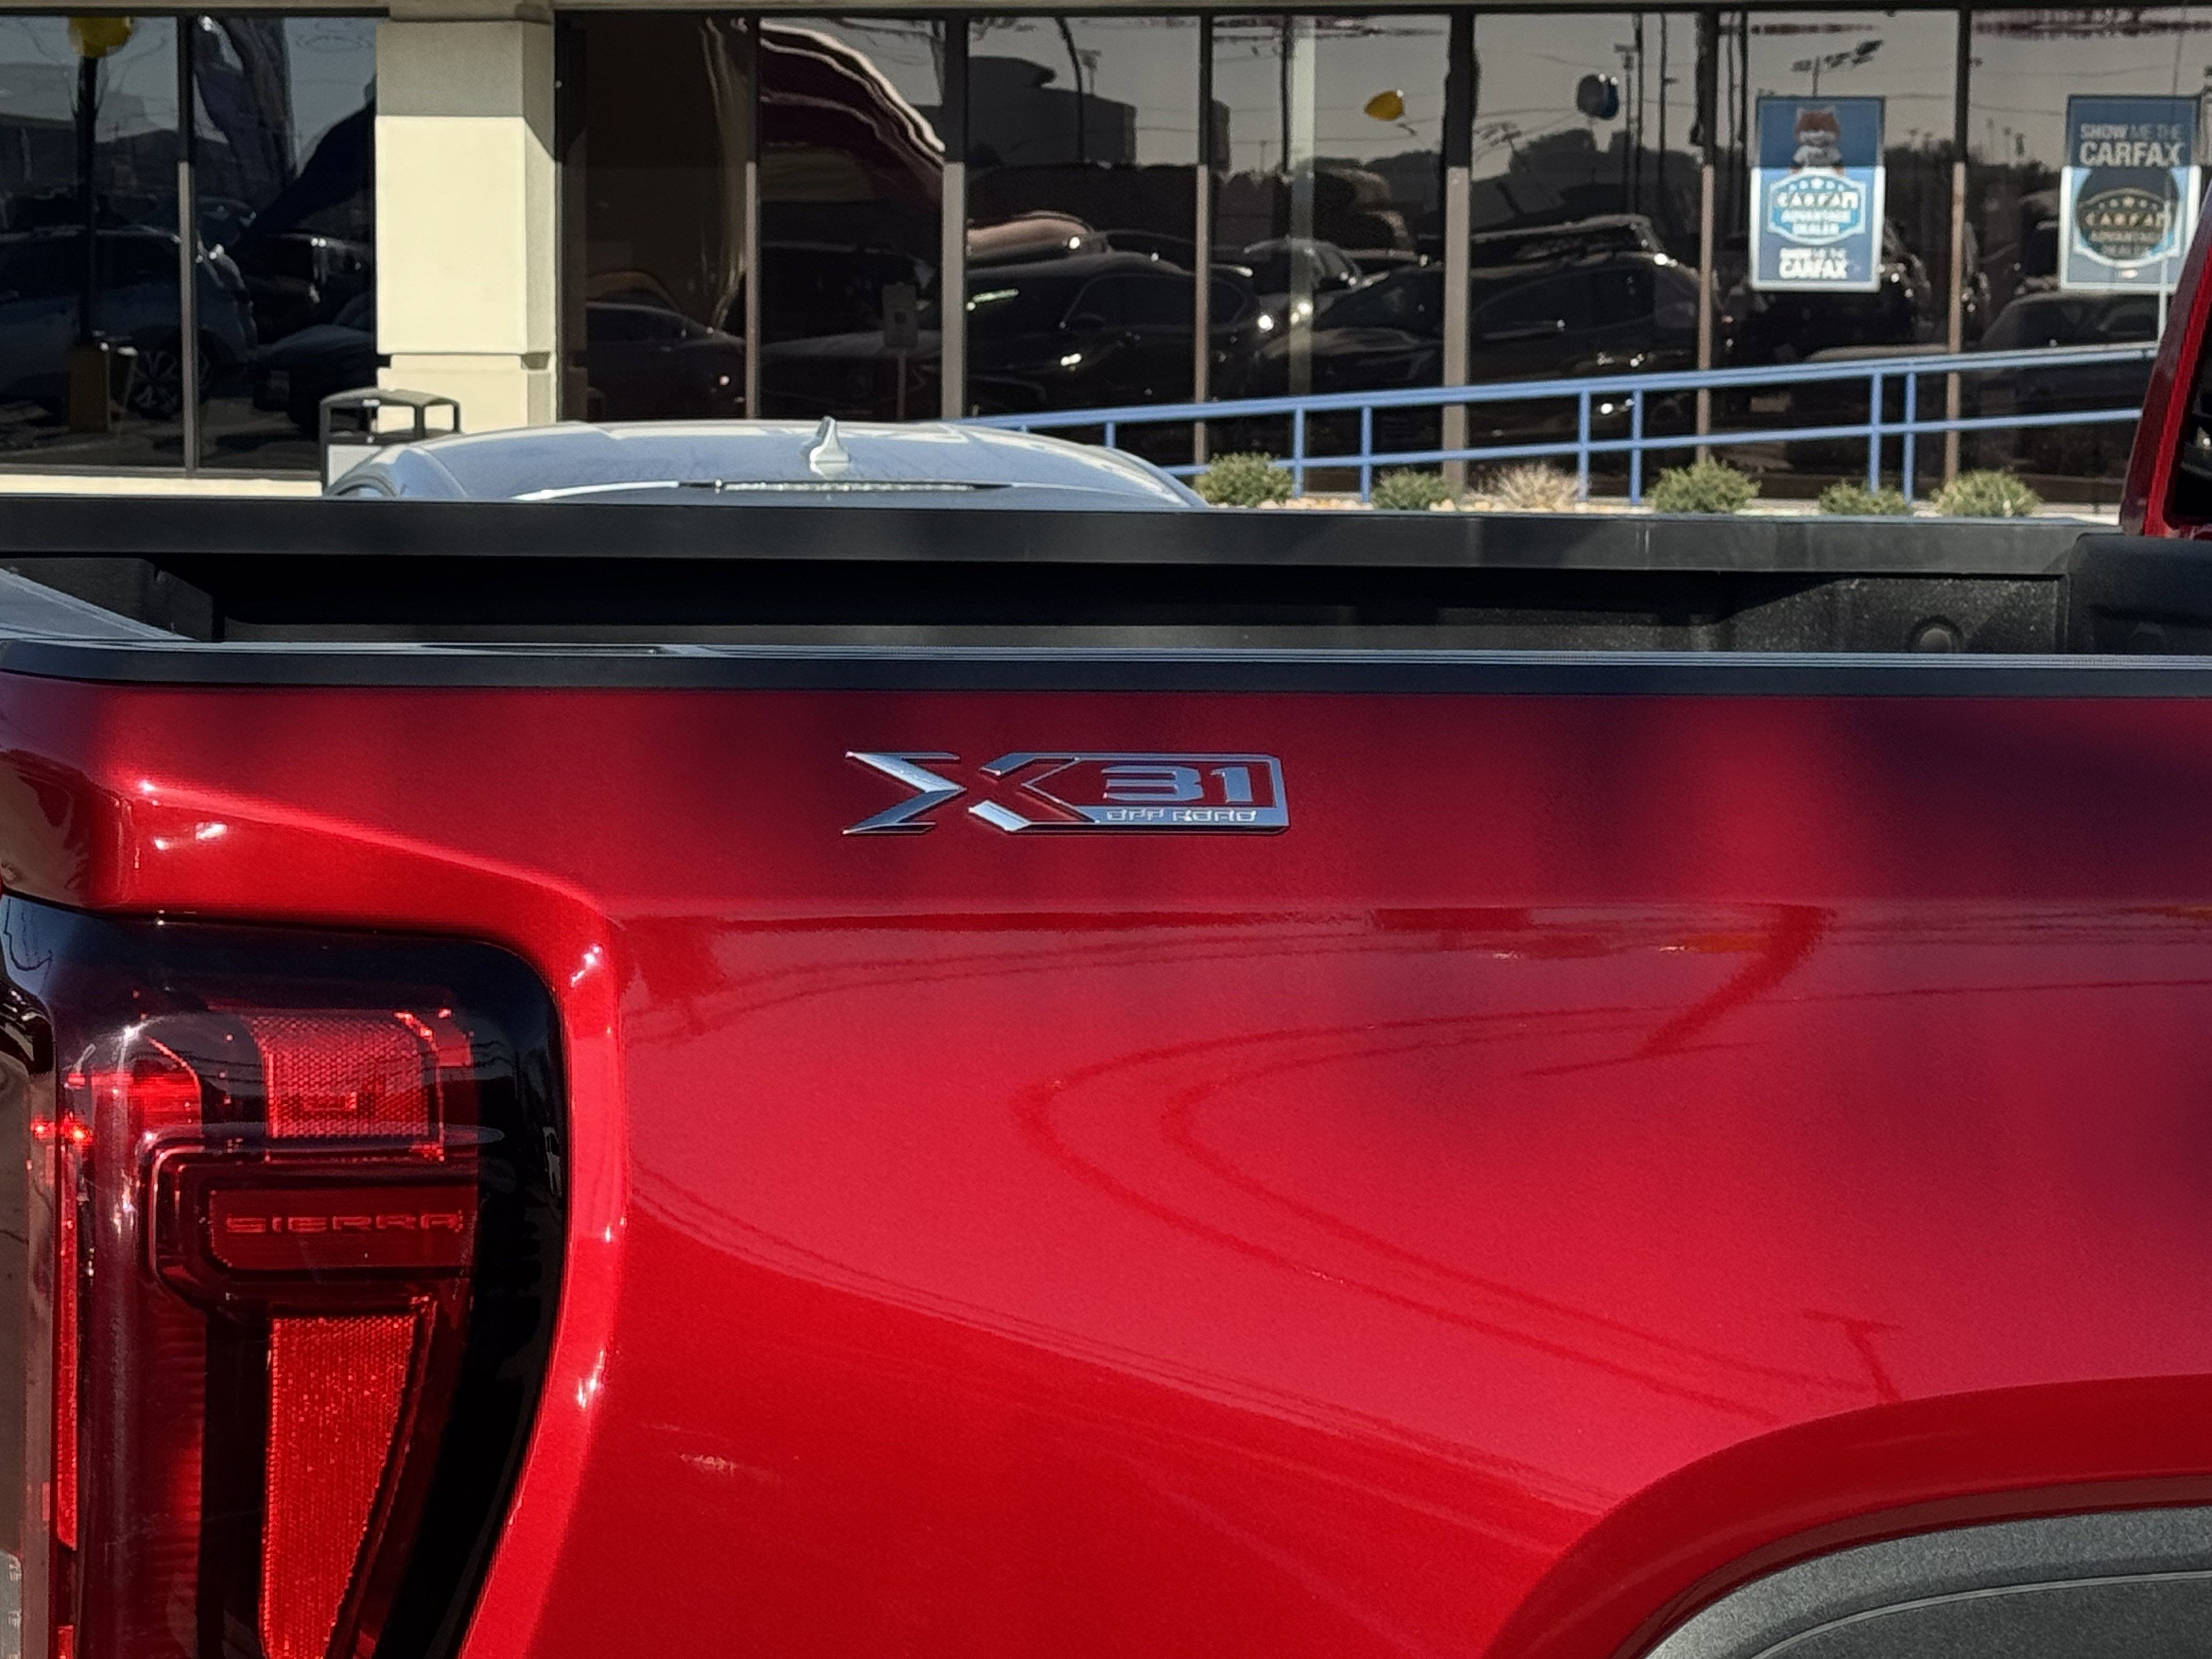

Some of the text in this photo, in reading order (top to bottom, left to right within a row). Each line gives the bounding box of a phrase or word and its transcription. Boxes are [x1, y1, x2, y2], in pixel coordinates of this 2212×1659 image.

[2080, 140, 2183, 167] CARFAX
[1779, 258, 1849, 279] CARFAX
[1106, 808, 1257, 822] OFF ROAD
[226, 1213, 463, 1233] SIERRA
